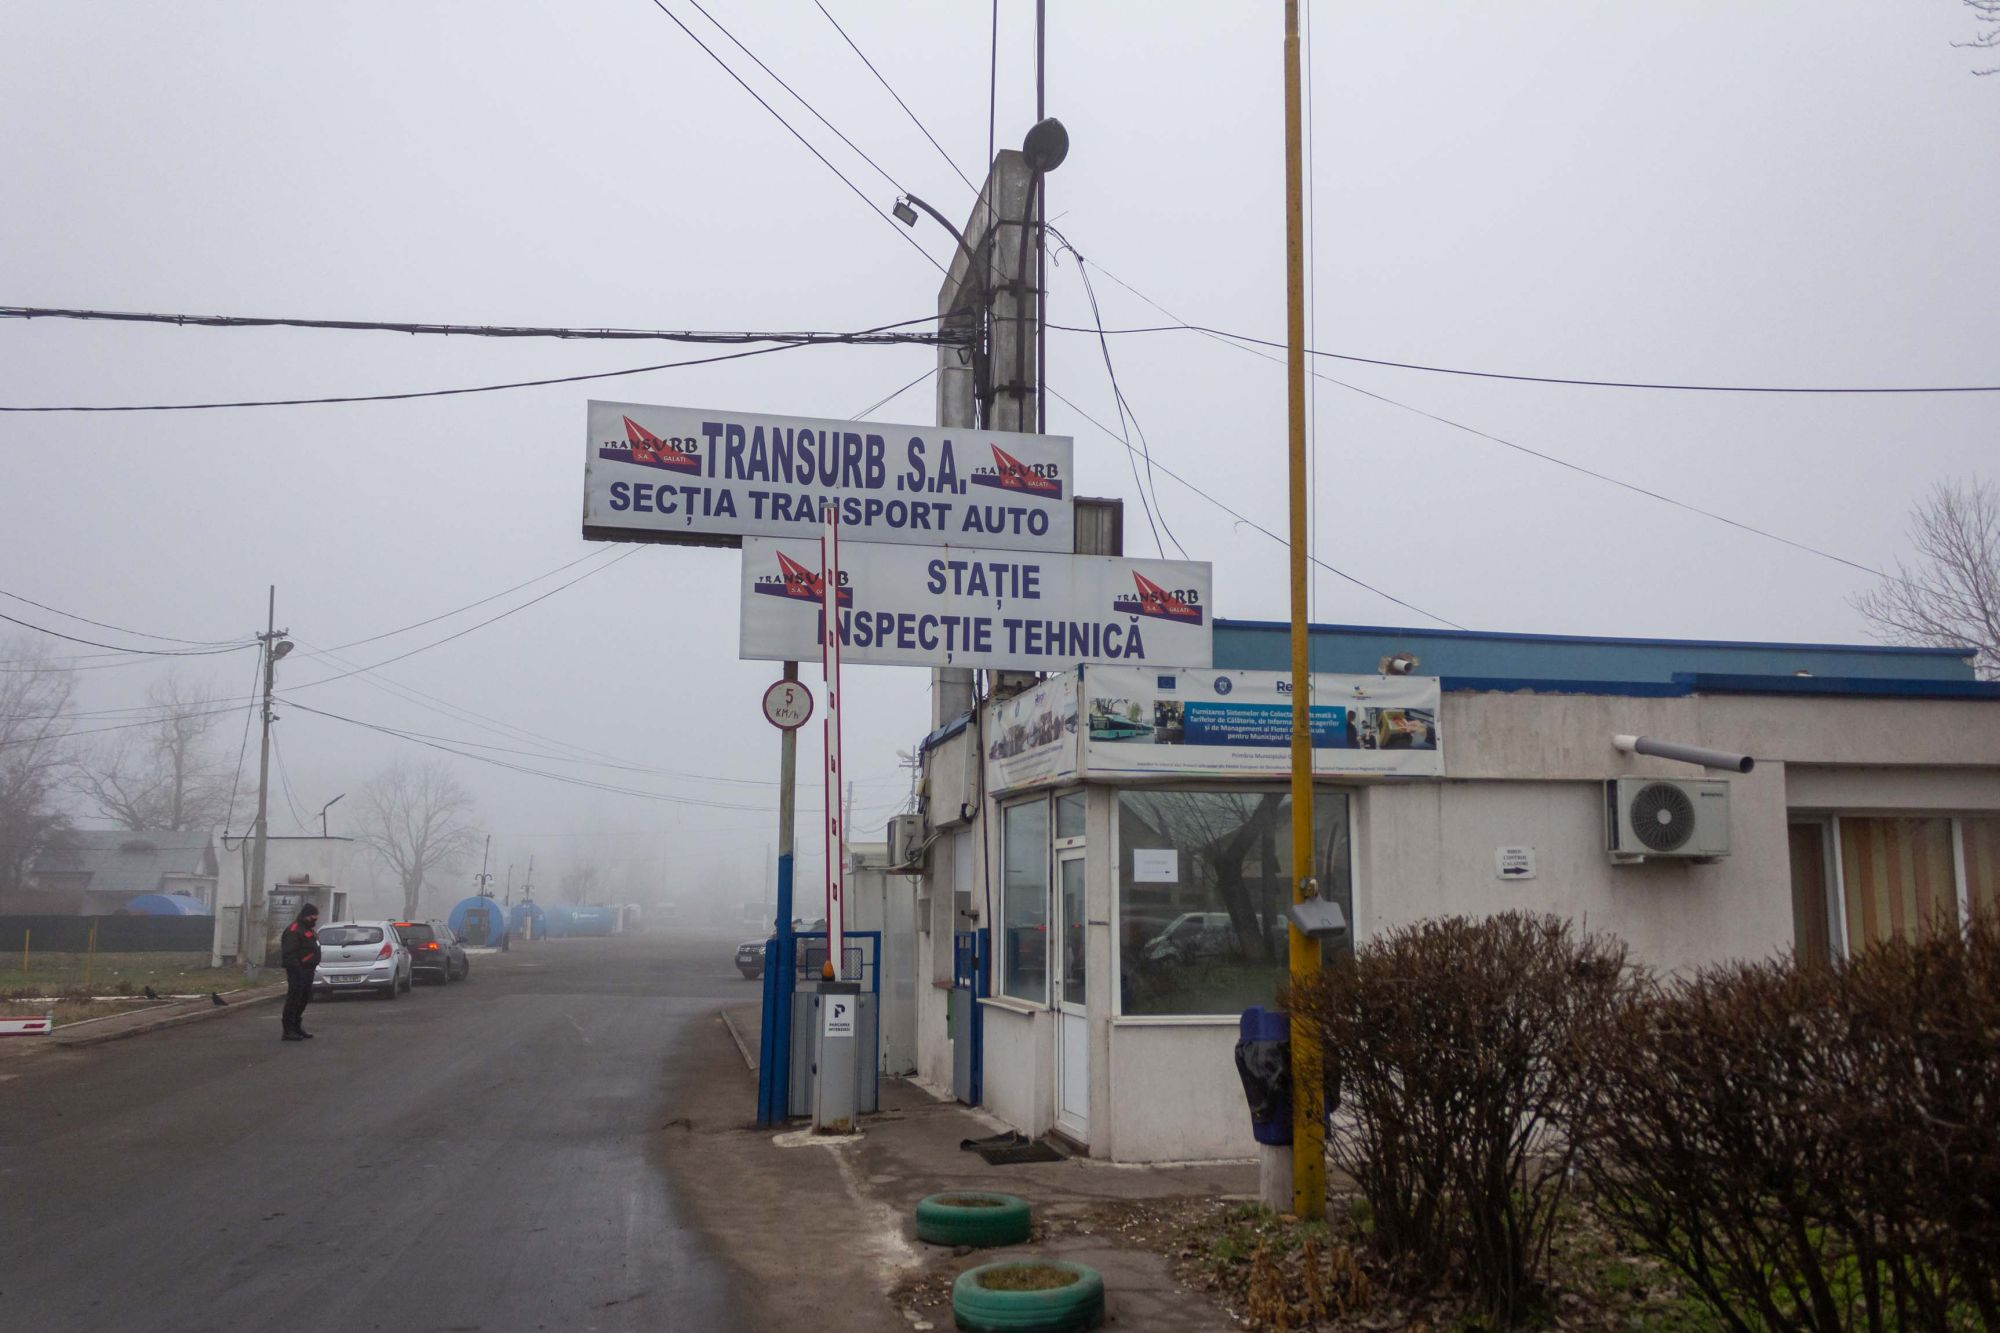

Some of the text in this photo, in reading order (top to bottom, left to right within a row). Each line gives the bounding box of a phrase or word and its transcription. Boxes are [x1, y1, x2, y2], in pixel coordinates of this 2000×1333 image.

[604, 437, 698, 453] TRANSURB
[702, 421, 886, 490] TRANSURB
[975, 463, 1059, 479] TRANSURB
[610, 481, 737, 526] SECȚIA
[961, 504, 1049, 536] AUTO
[759, 570, 849, 586] TRANSUB
[927, 559, 1041, 610] STAȚIE
[1117, 589, 1199, 604] TRANSURB
[1003, 615, 1145, 660] TEHNICĂ
[785, 688, 794, 704] 5
[776, 707, 799, 719] KM/h
[1220, 725, 1263, 733] Management
